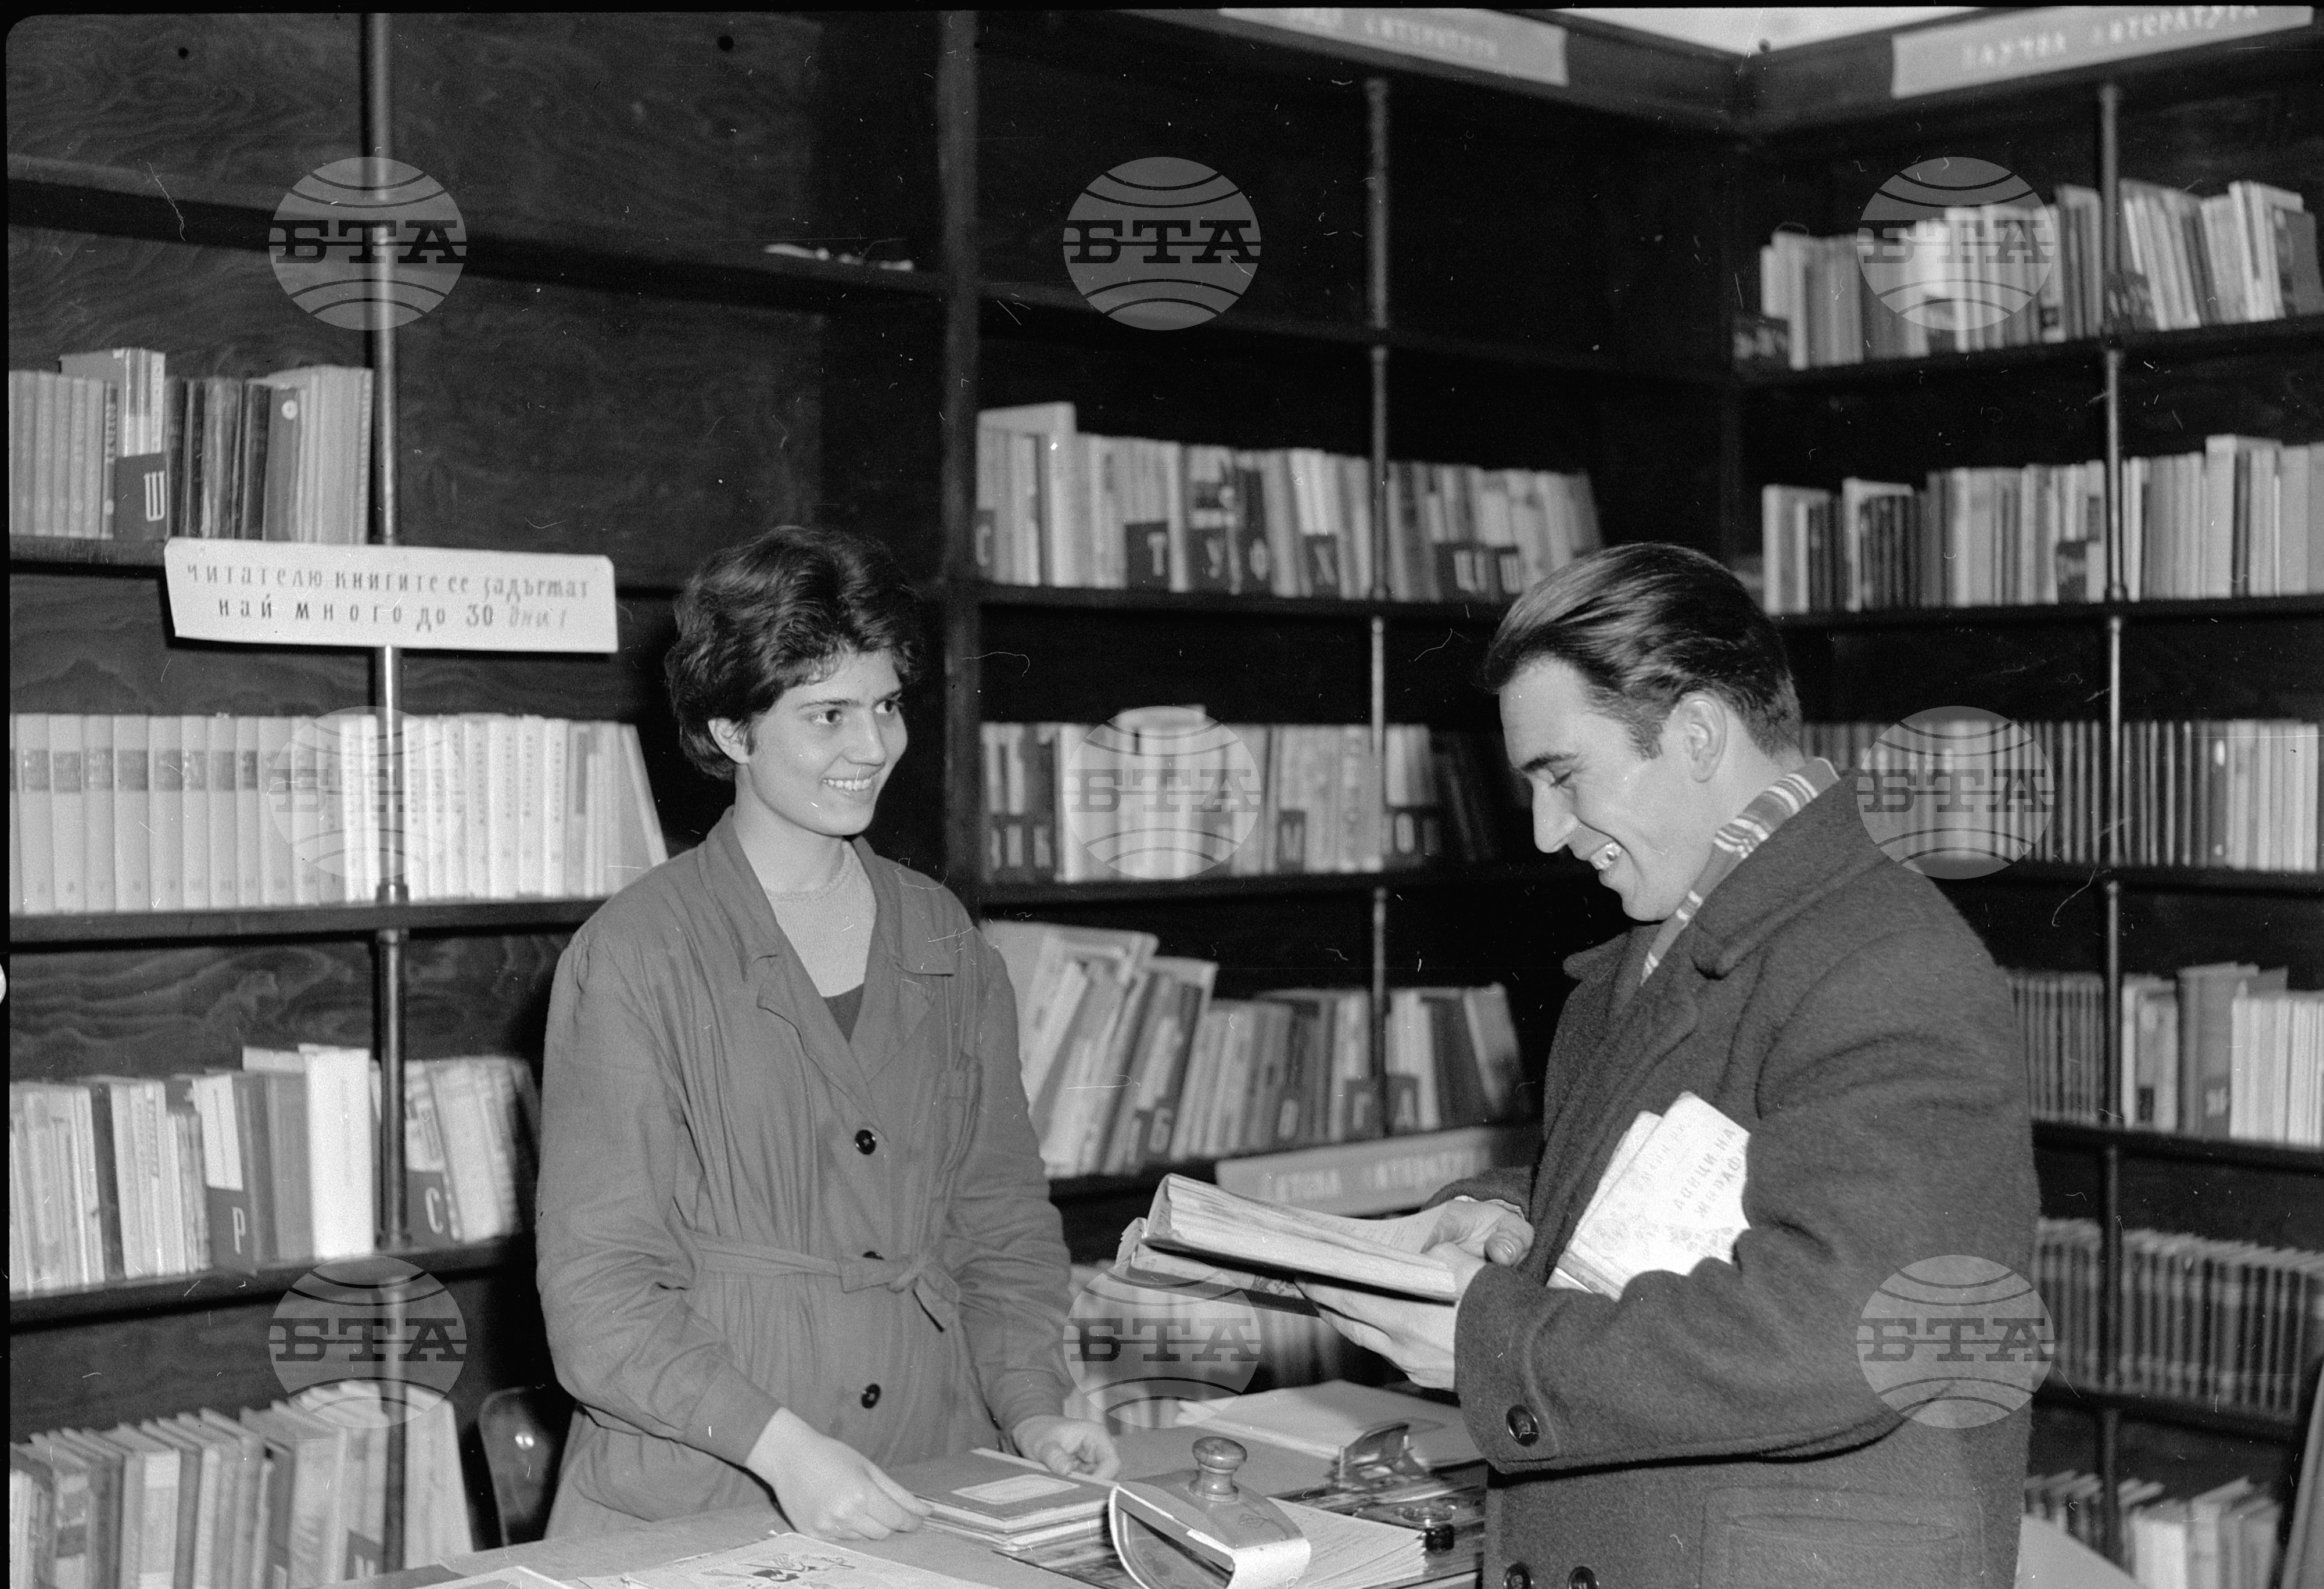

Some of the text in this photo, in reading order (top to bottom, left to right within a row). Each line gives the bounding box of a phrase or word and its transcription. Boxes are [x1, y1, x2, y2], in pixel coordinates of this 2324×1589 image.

[144, 471, 165, 522] Ш
[187, 564, 322, 589] читателю
[335, 572, 437, 594] книгите
[219, 594, 272, 619] най
[296, 601, 402, 623] много
[417, 608, 446, 633] до
[467, 604, 494, 627] 30
[1713, 1126, 1736, 1151] НА
[233, 1207, 246, 1254] Р
[425, 1187, 443, 1234] С
